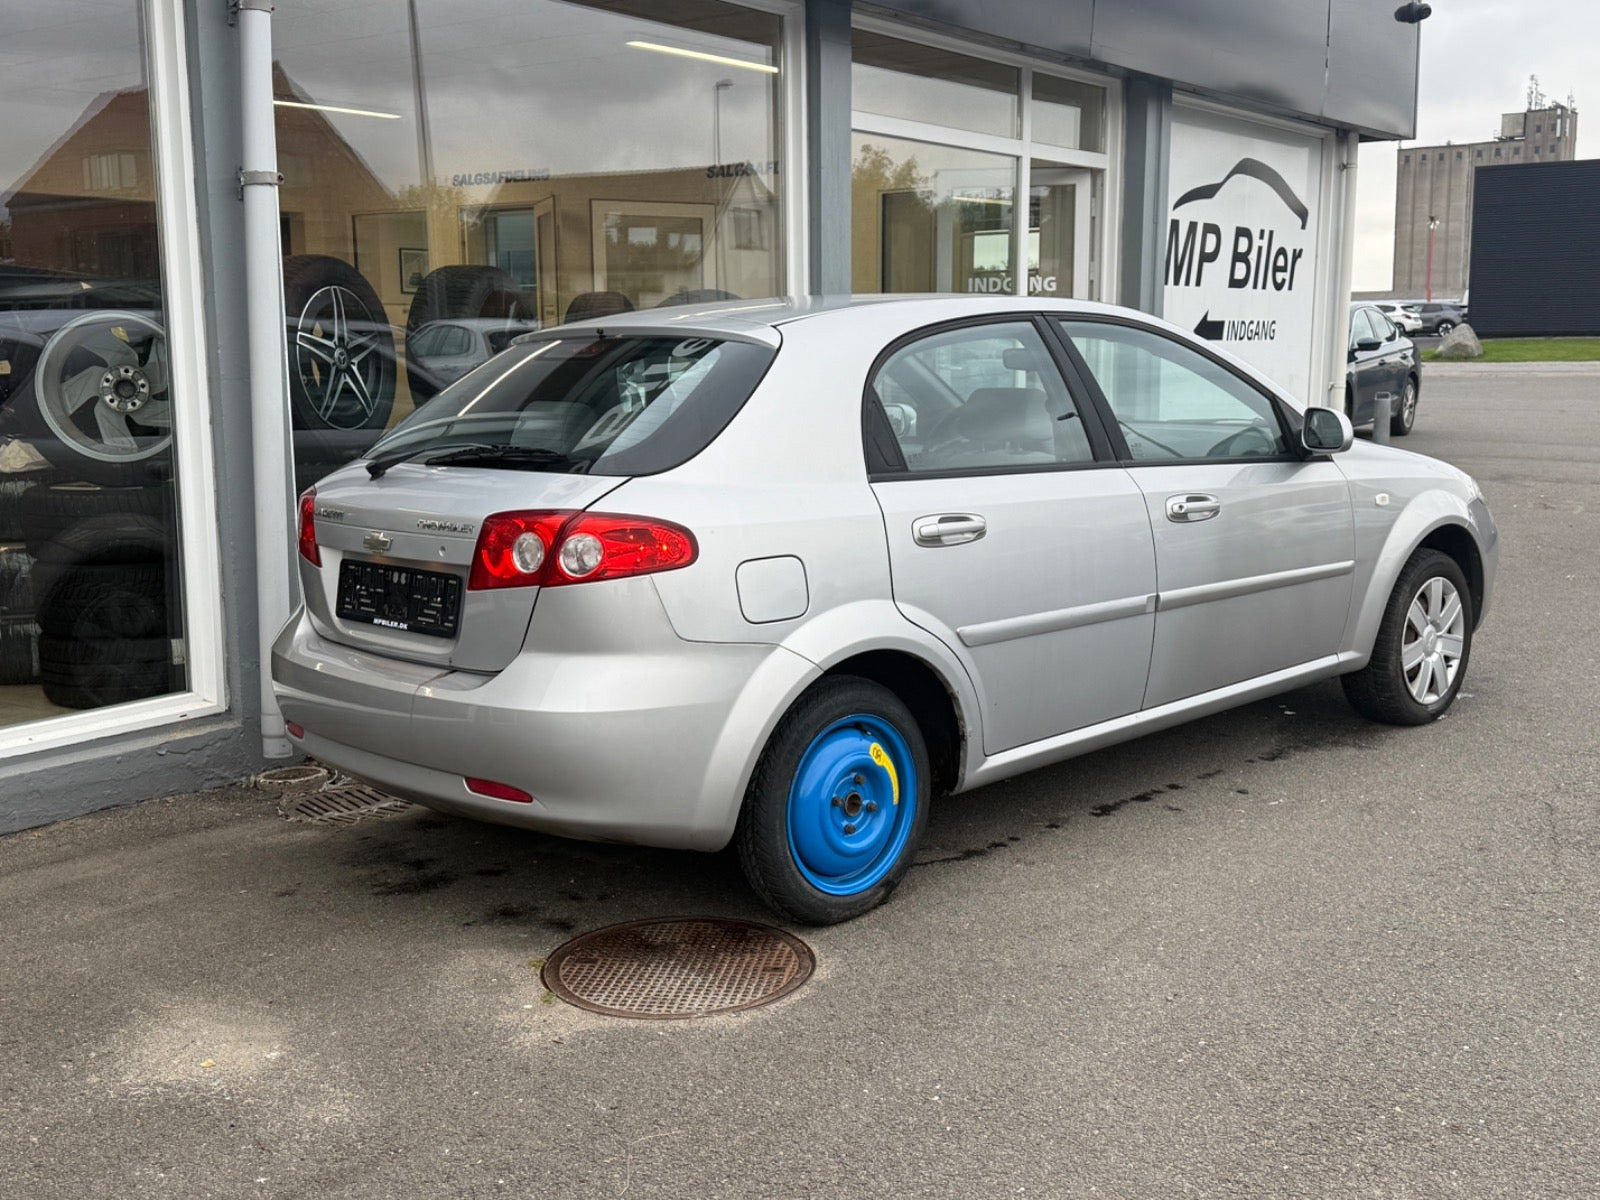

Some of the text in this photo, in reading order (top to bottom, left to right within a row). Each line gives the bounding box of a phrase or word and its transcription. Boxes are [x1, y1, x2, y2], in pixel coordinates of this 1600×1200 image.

[452, 168, 550, 187] SALGSAFDELING
[1164, 218, 1303, 291] MP Biler
[968, 276, 1057, 292] INDGNG
[1226, 319, 1276, 341] INDGANG
